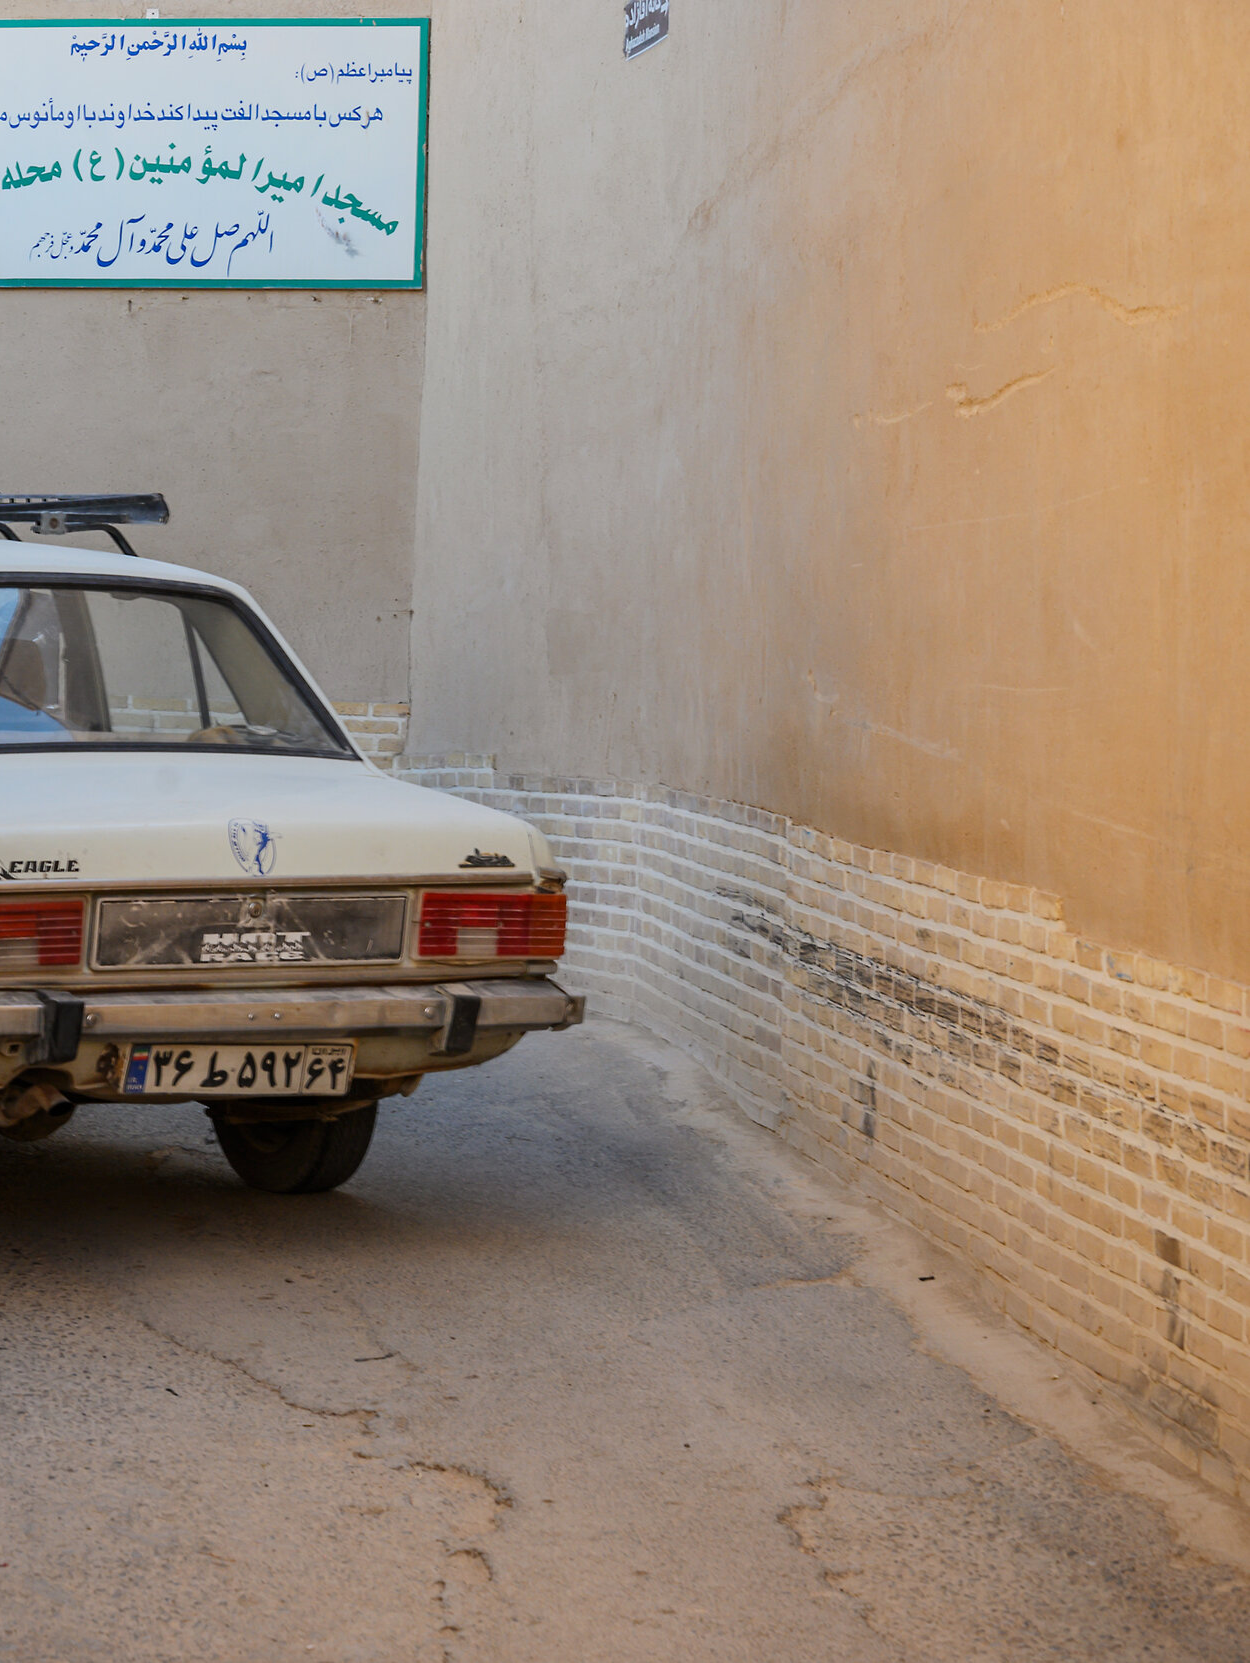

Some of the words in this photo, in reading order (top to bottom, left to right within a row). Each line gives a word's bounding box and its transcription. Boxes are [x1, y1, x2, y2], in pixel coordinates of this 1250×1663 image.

[64, 104, 82, 129] او
[83, 104, 97, 128] با
[98, 102, 156, 129] خداوند
[156, 103, 184, 121] کند
[187, 103, 219, 131] پیدا
[220, 100, 260, 121] الفت
[261, 104, 312, 127] مسجد
[314, 103, 327, 127] با
[329, 105, 362, 128] کس
[359, 107, 384, 129] هر
[1, 160, 63, 190] محله
[72, 147, 126, 182] (ع)
[128, 142, 265, 185] المؤمنین
[253, 173, 326, 204] امیر
[321, 184, 400, 236] مسجد
[190, 221, 240, 268] صل
[9, 859, 80, 873] EAGLE
[153, 1049, 195, 1087] ۳۶
[200, 1051, 229, 1088] ط
[237, 1051, 302, 1088] ۵۹۲
[305, 1058, 347, 1090] ۶۴
